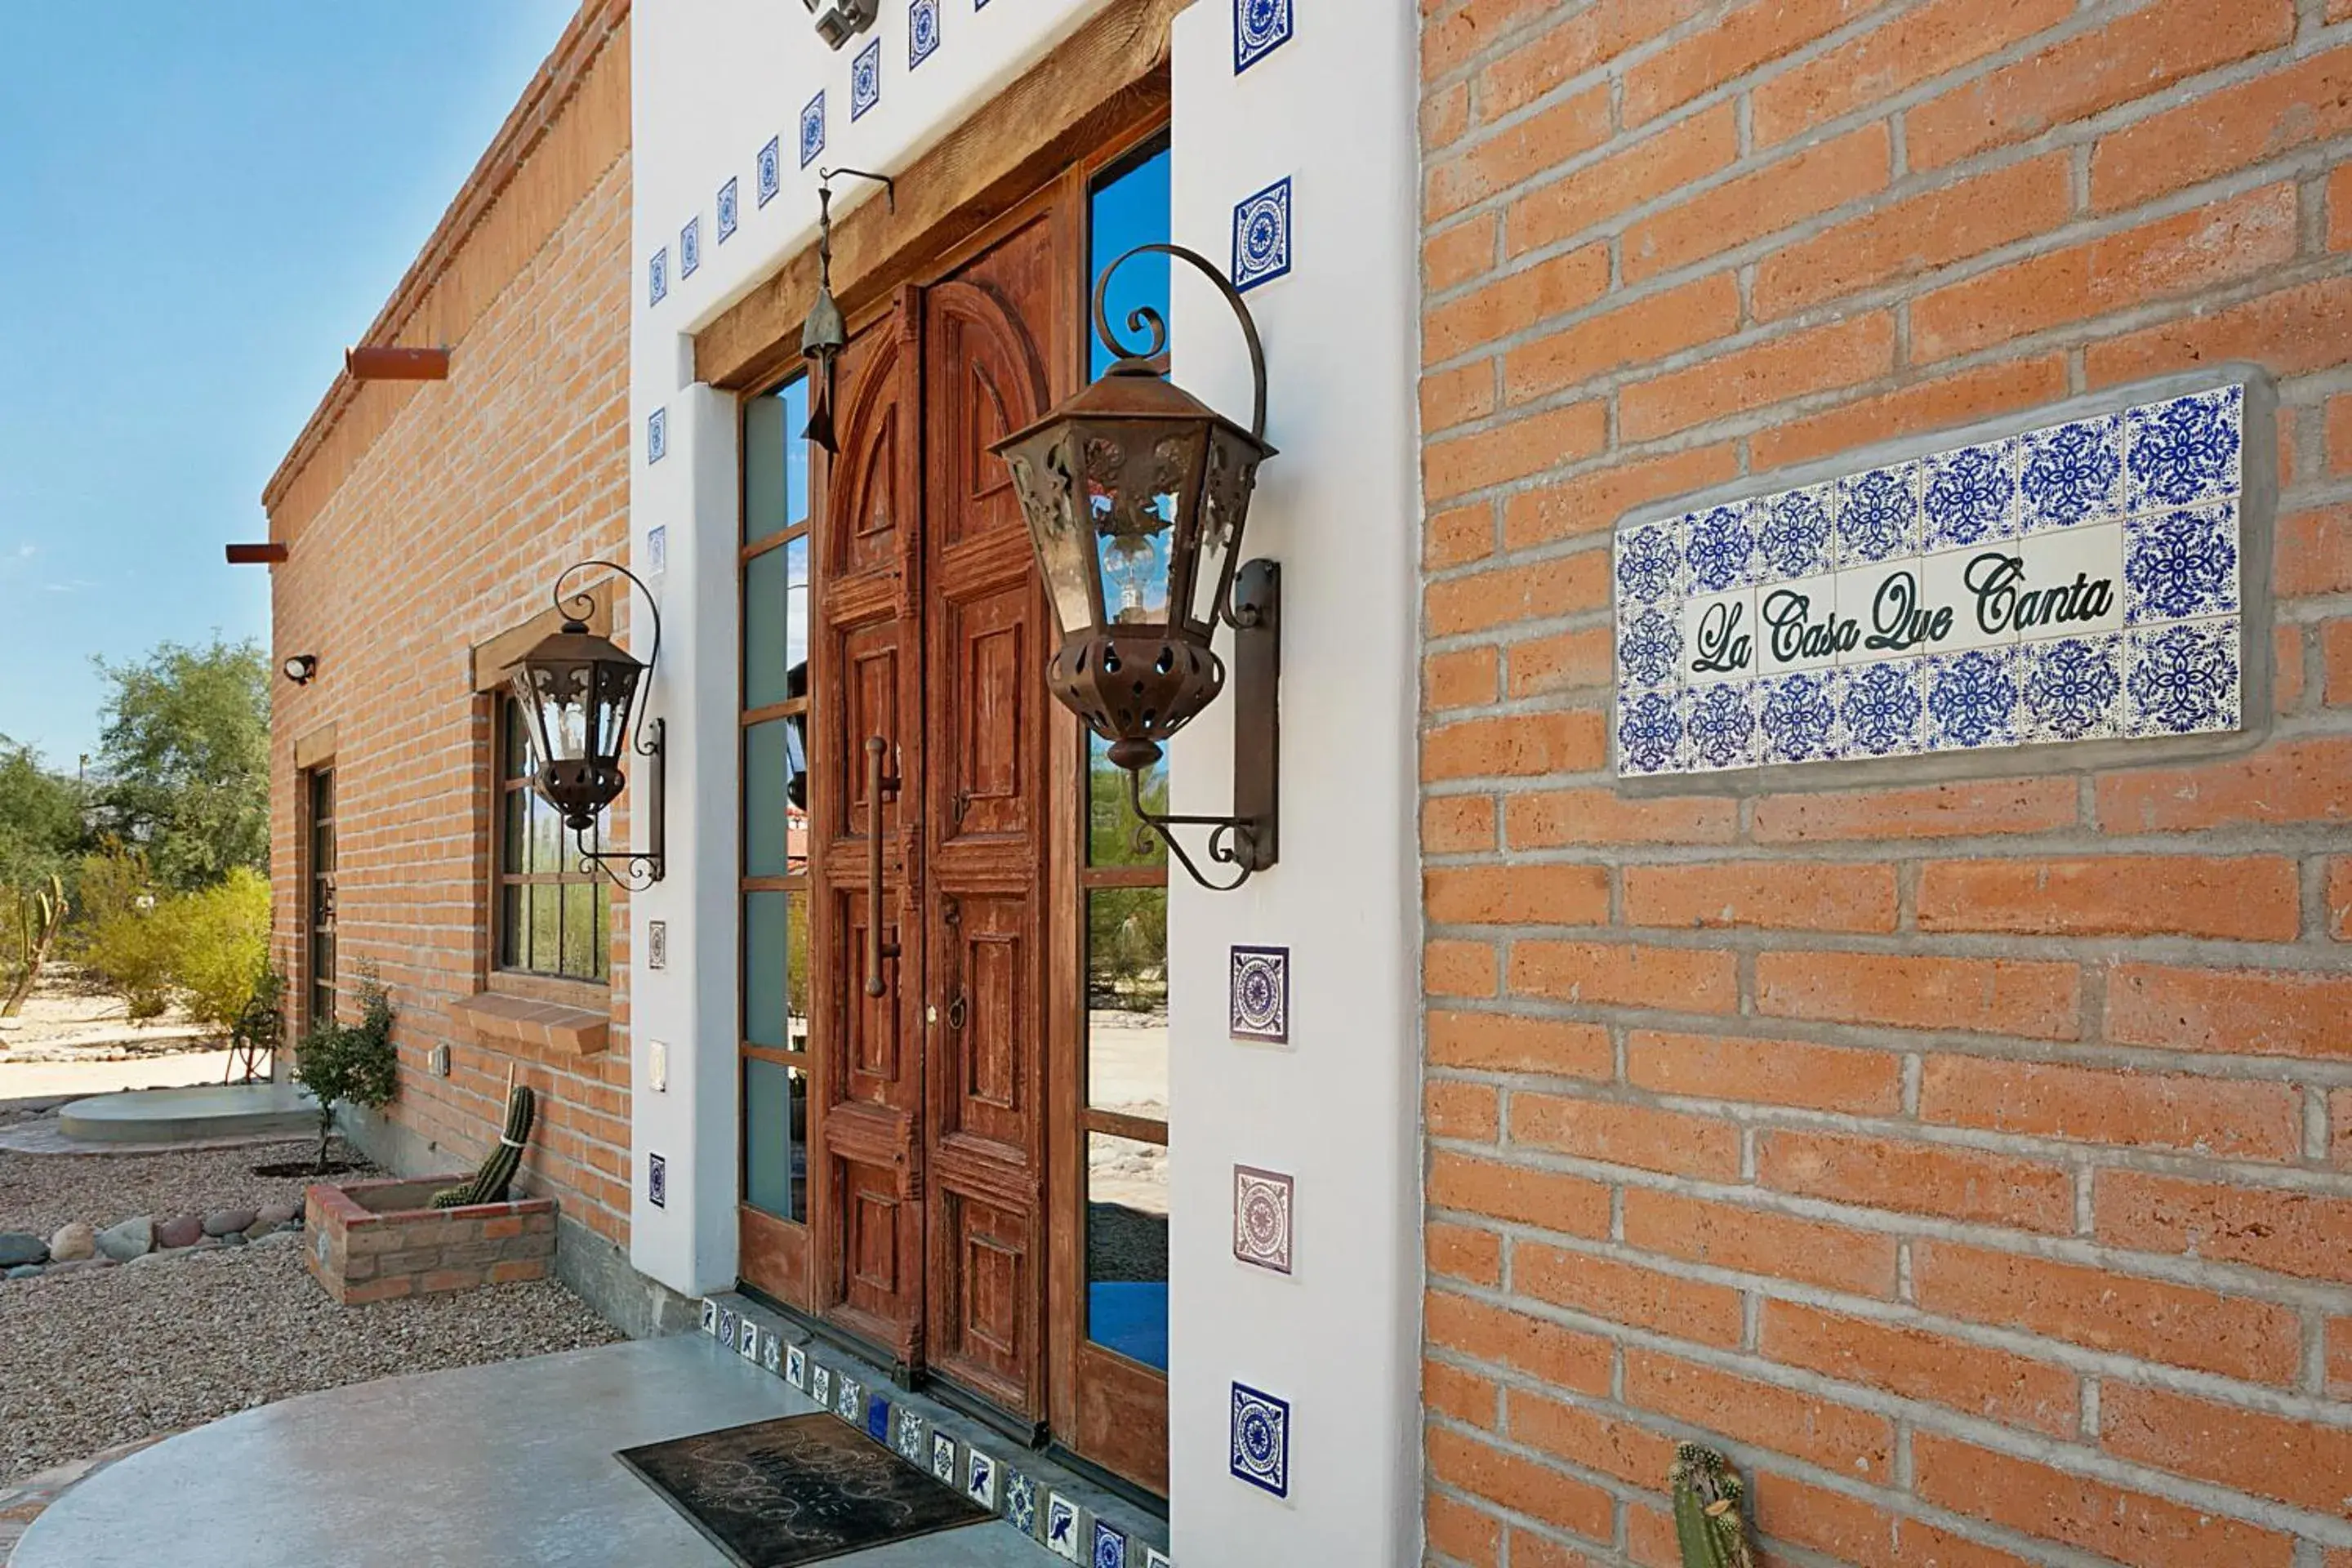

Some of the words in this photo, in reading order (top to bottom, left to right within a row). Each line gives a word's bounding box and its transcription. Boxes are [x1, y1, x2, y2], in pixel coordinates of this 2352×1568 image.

[1691, 601, 1753, 672] La
[1762, 589, 1861, 662] Casa
[1864, 571, 1953, 651] Que
[1963, 552, 2114, 635] Canta
